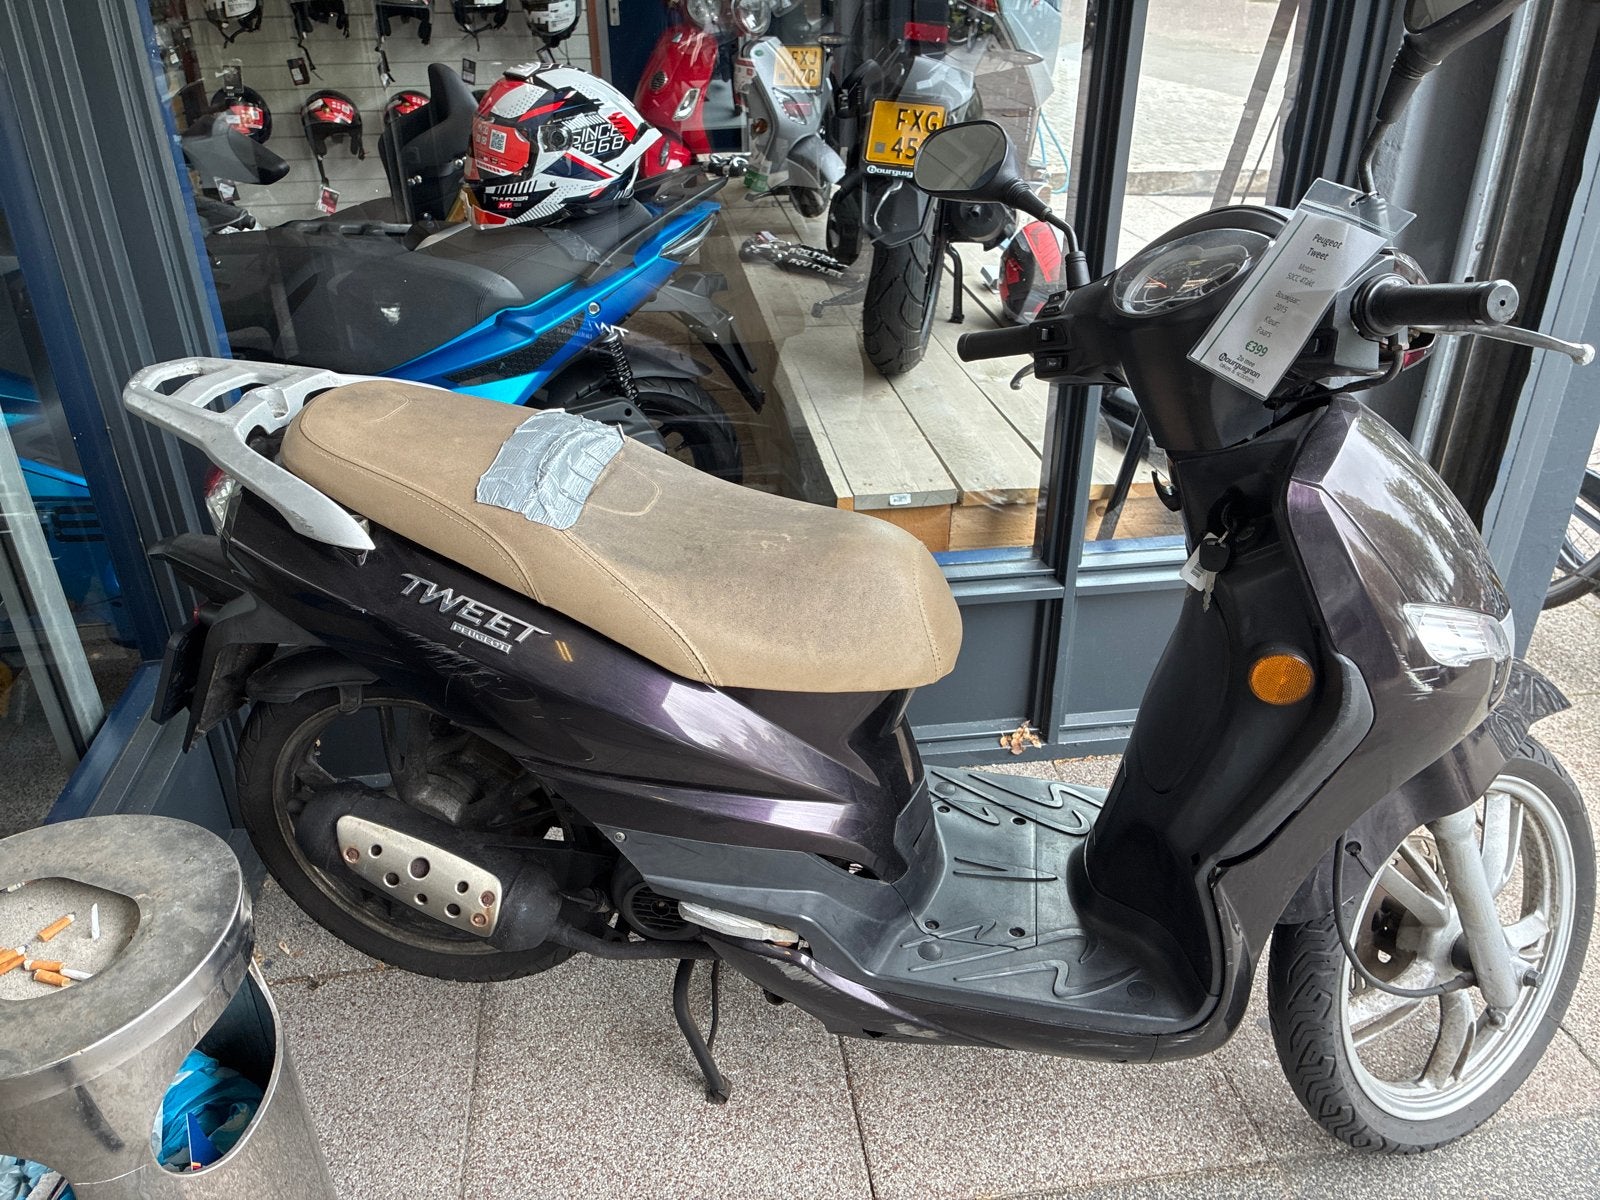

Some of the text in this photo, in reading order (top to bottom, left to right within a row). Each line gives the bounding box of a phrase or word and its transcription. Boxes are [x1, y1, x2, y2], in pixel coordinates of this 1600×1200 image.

[896, 108, 938, 134] FXG
[891, 137, 917, 160] 45
[1312, 233, 1343, 250] Peugeot
[1306, 247, 1330, 261] Tweet
[1273, 303, 1289, 314] 2015
[1256, 327, 1272, 338] Paars
[1245, 340, 1269, 357] €399
[401, 573, 551, 643] TWEET
[452, 622, 511, 653] PEUGEOT
